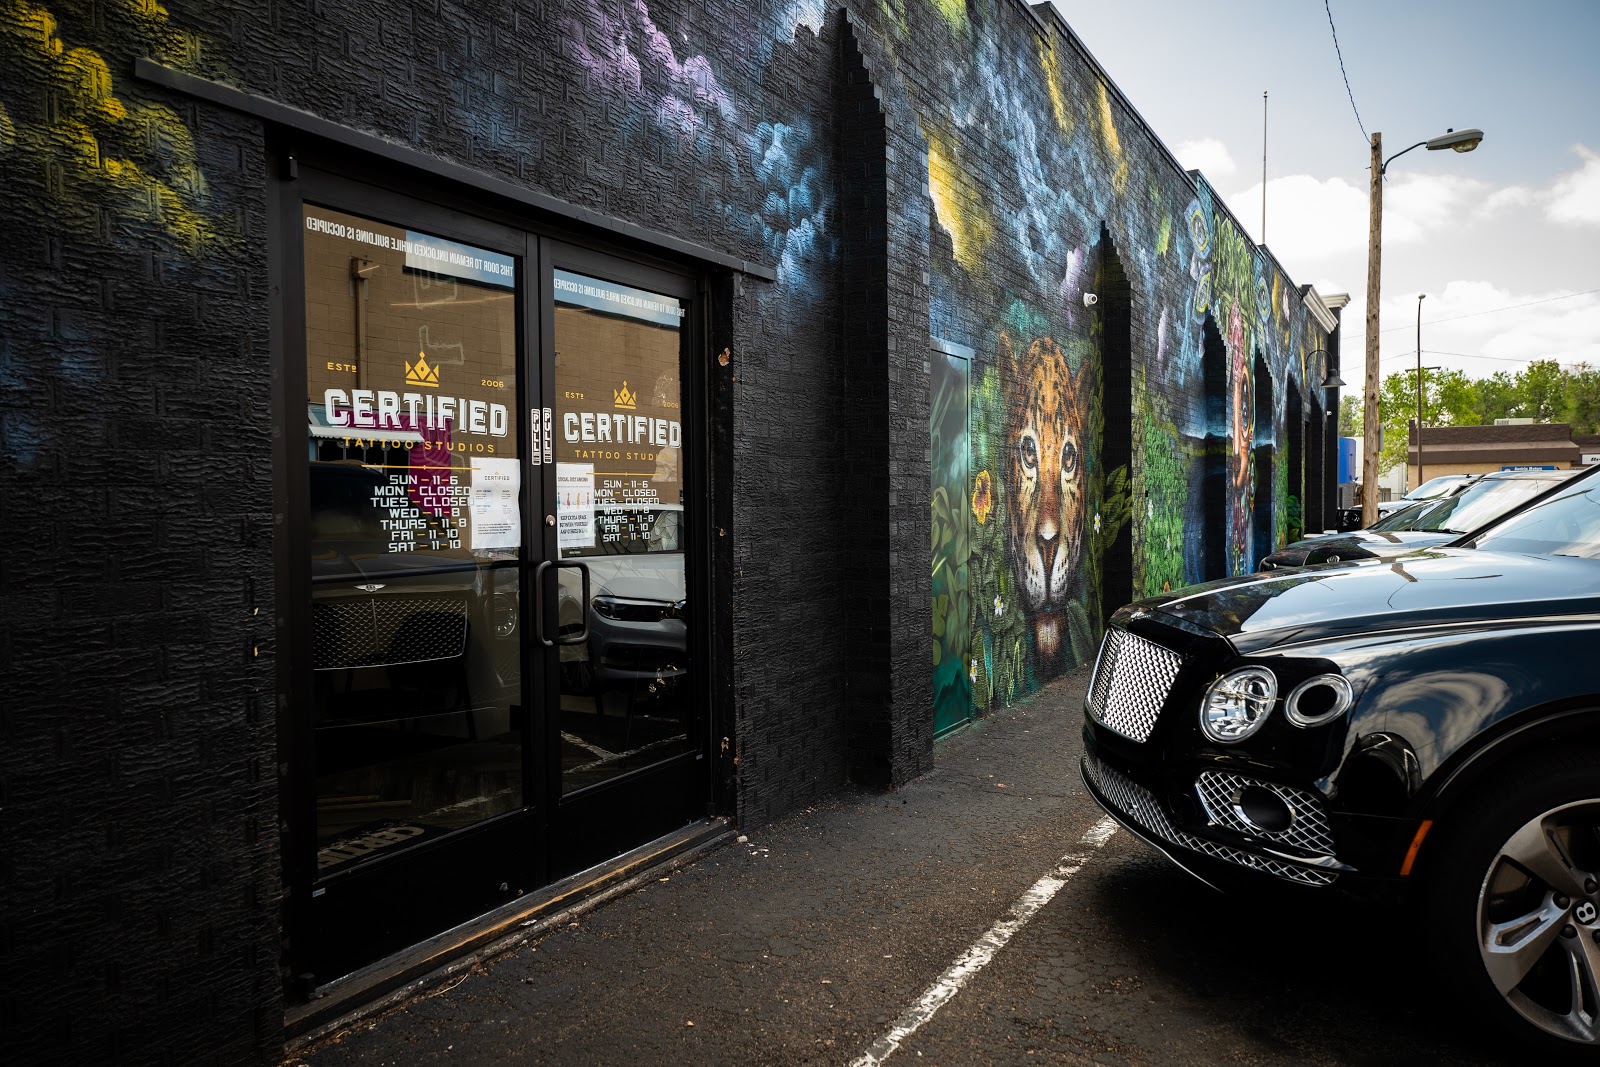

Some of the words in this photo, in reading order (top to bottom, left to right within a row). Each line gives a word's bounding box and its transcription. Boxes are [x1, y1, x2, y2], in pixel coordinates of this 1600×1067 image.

[481, 379, 504, 388] 2006
[324, 388, 508, 437] CERTIFIED
[563, 412, 682, 449] CERTIFIED
[343, 436, 414, 449] TATTOO
[424, 442, 495, 453] STUDIOS
[575, 450, 620, 459] TATTOO
[390, 475, 418, 484] SUN
[604, 480, 622, 488] SUN
[374, 486, 404, 496] MON
[419, 486, 471, 496] CLOSED
[370, 498, 408, 508] TUES
[389, 509, 419, 519] WED
[604, 507, 622, 515] WED
[380, 519, 426, 530] THURS
[598, 516, 628, 524] THURS
[605, 525, 619, 533] FRI
[392, 531, 414, 541] FRI
[603, 534, 621, 542] SAT
[389, 542, 417, 552] SAT
[1576, 902, 1596, 923] B
